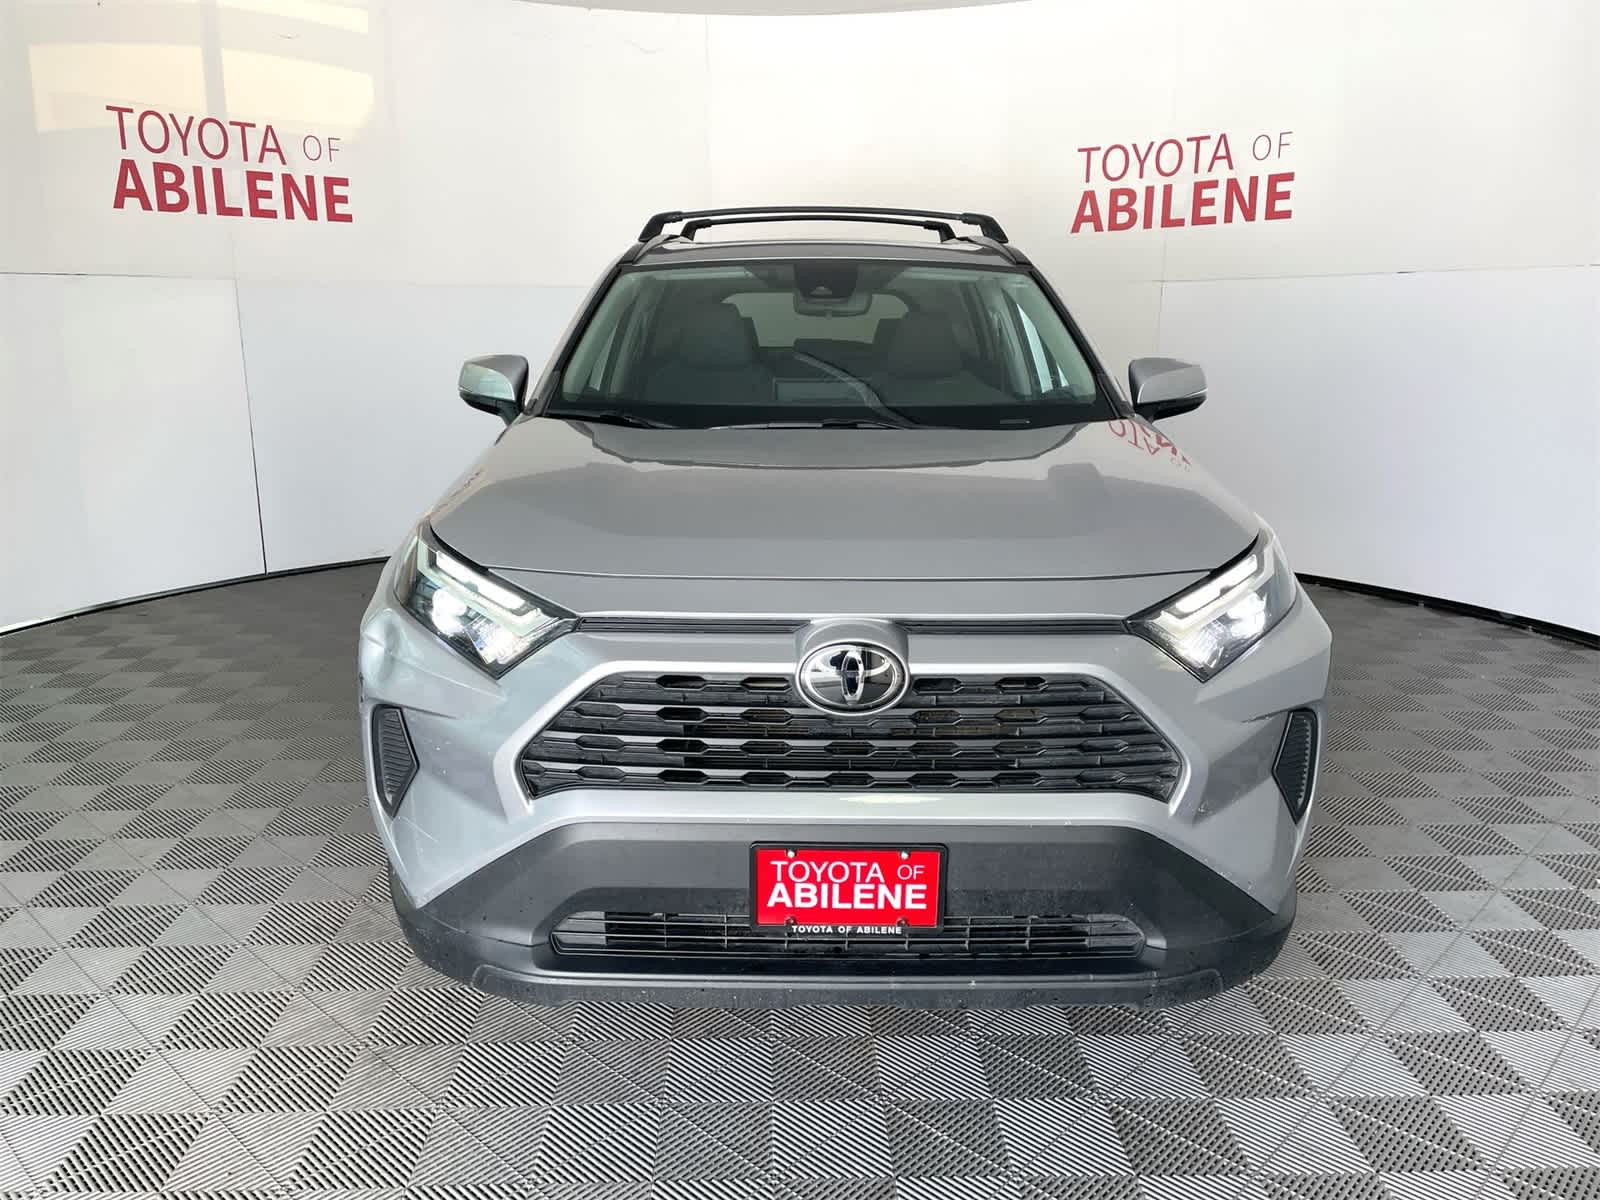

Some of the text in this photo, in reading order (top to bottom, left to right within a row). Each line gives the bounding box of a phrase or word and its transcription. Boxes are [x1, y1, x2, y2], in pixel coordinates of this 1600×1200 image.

[105, 104, 342, 166] TOYOTA OF
[1077, 131, 1294, 184] TOYOTA OF
[112, 158, 354, 223] ABILENE
[1069, 171, 1296, 234] ABILENE
[766, 882, 928, 910] ABILENE
[769, 860, 926, 884] TOYOTA OF
[791, 925, 903, 935] TOYOTA OF ABILENE
